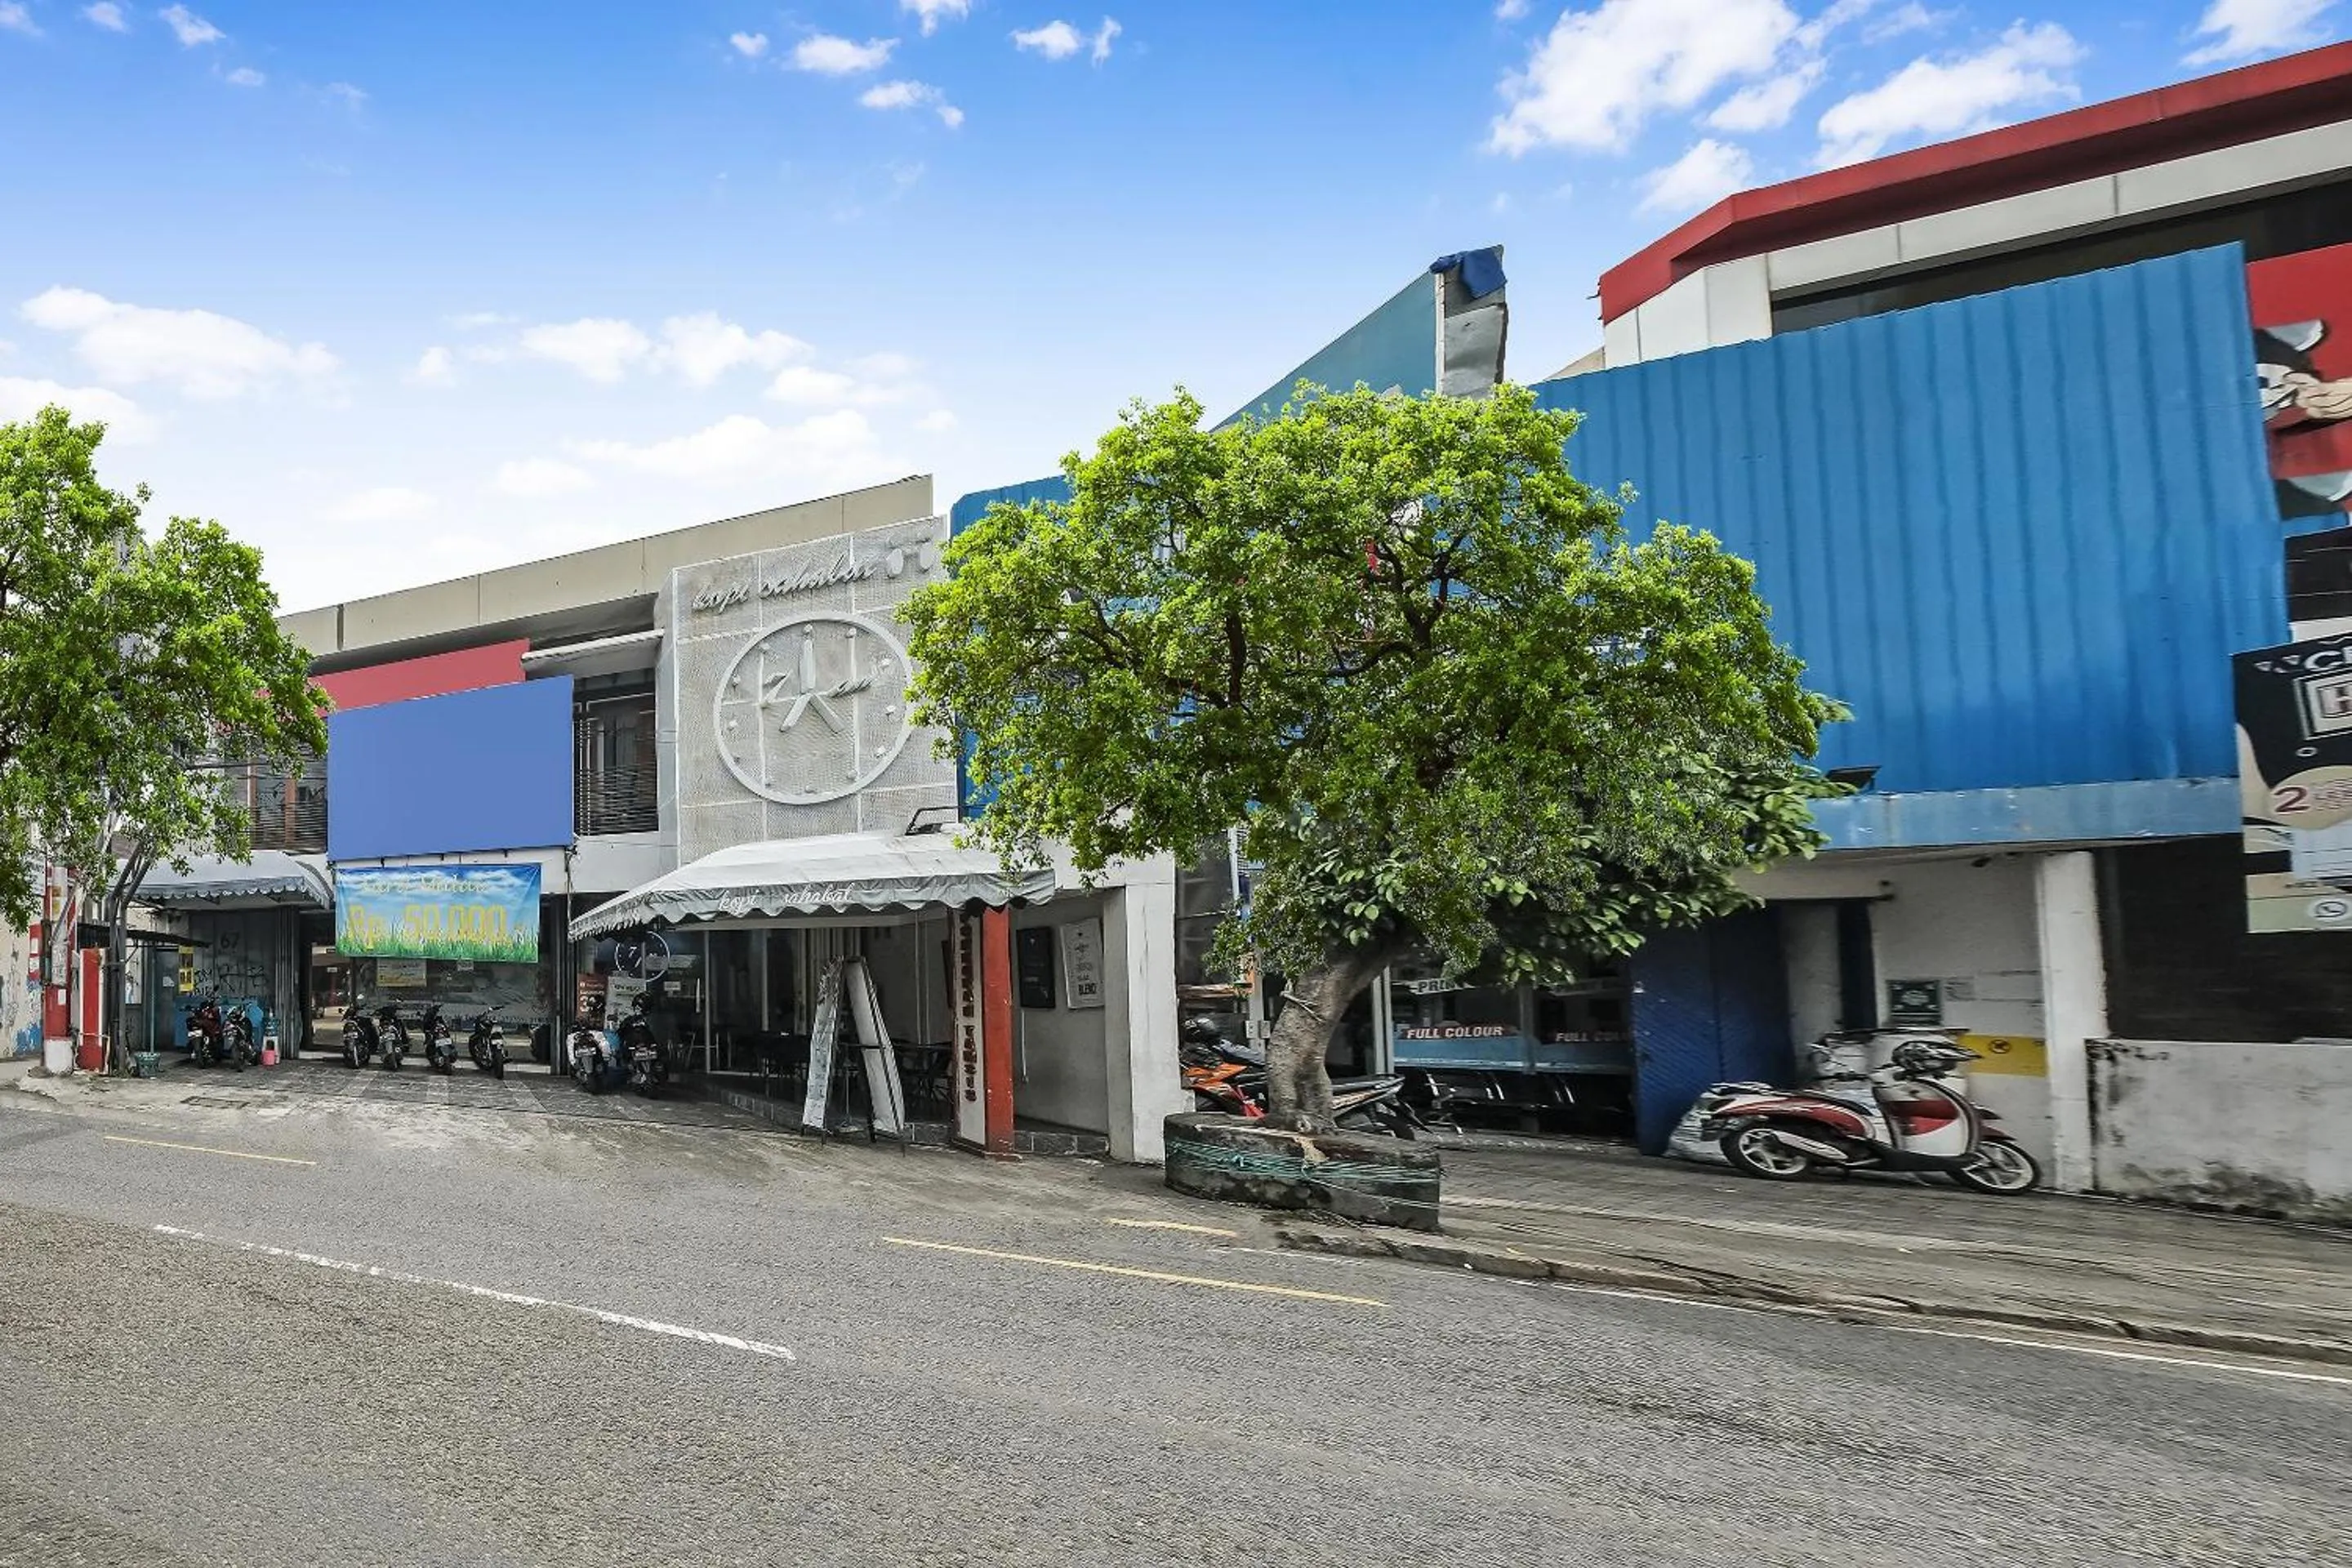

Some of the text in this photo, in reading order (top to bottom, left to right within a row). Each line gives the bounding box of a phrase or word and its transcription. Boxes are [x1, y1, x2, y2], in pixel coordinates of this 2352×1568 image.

[719, 883, 856, 917] kopi sahabat
[1406, 1026, 1503, 1040] FULL COLOUR
